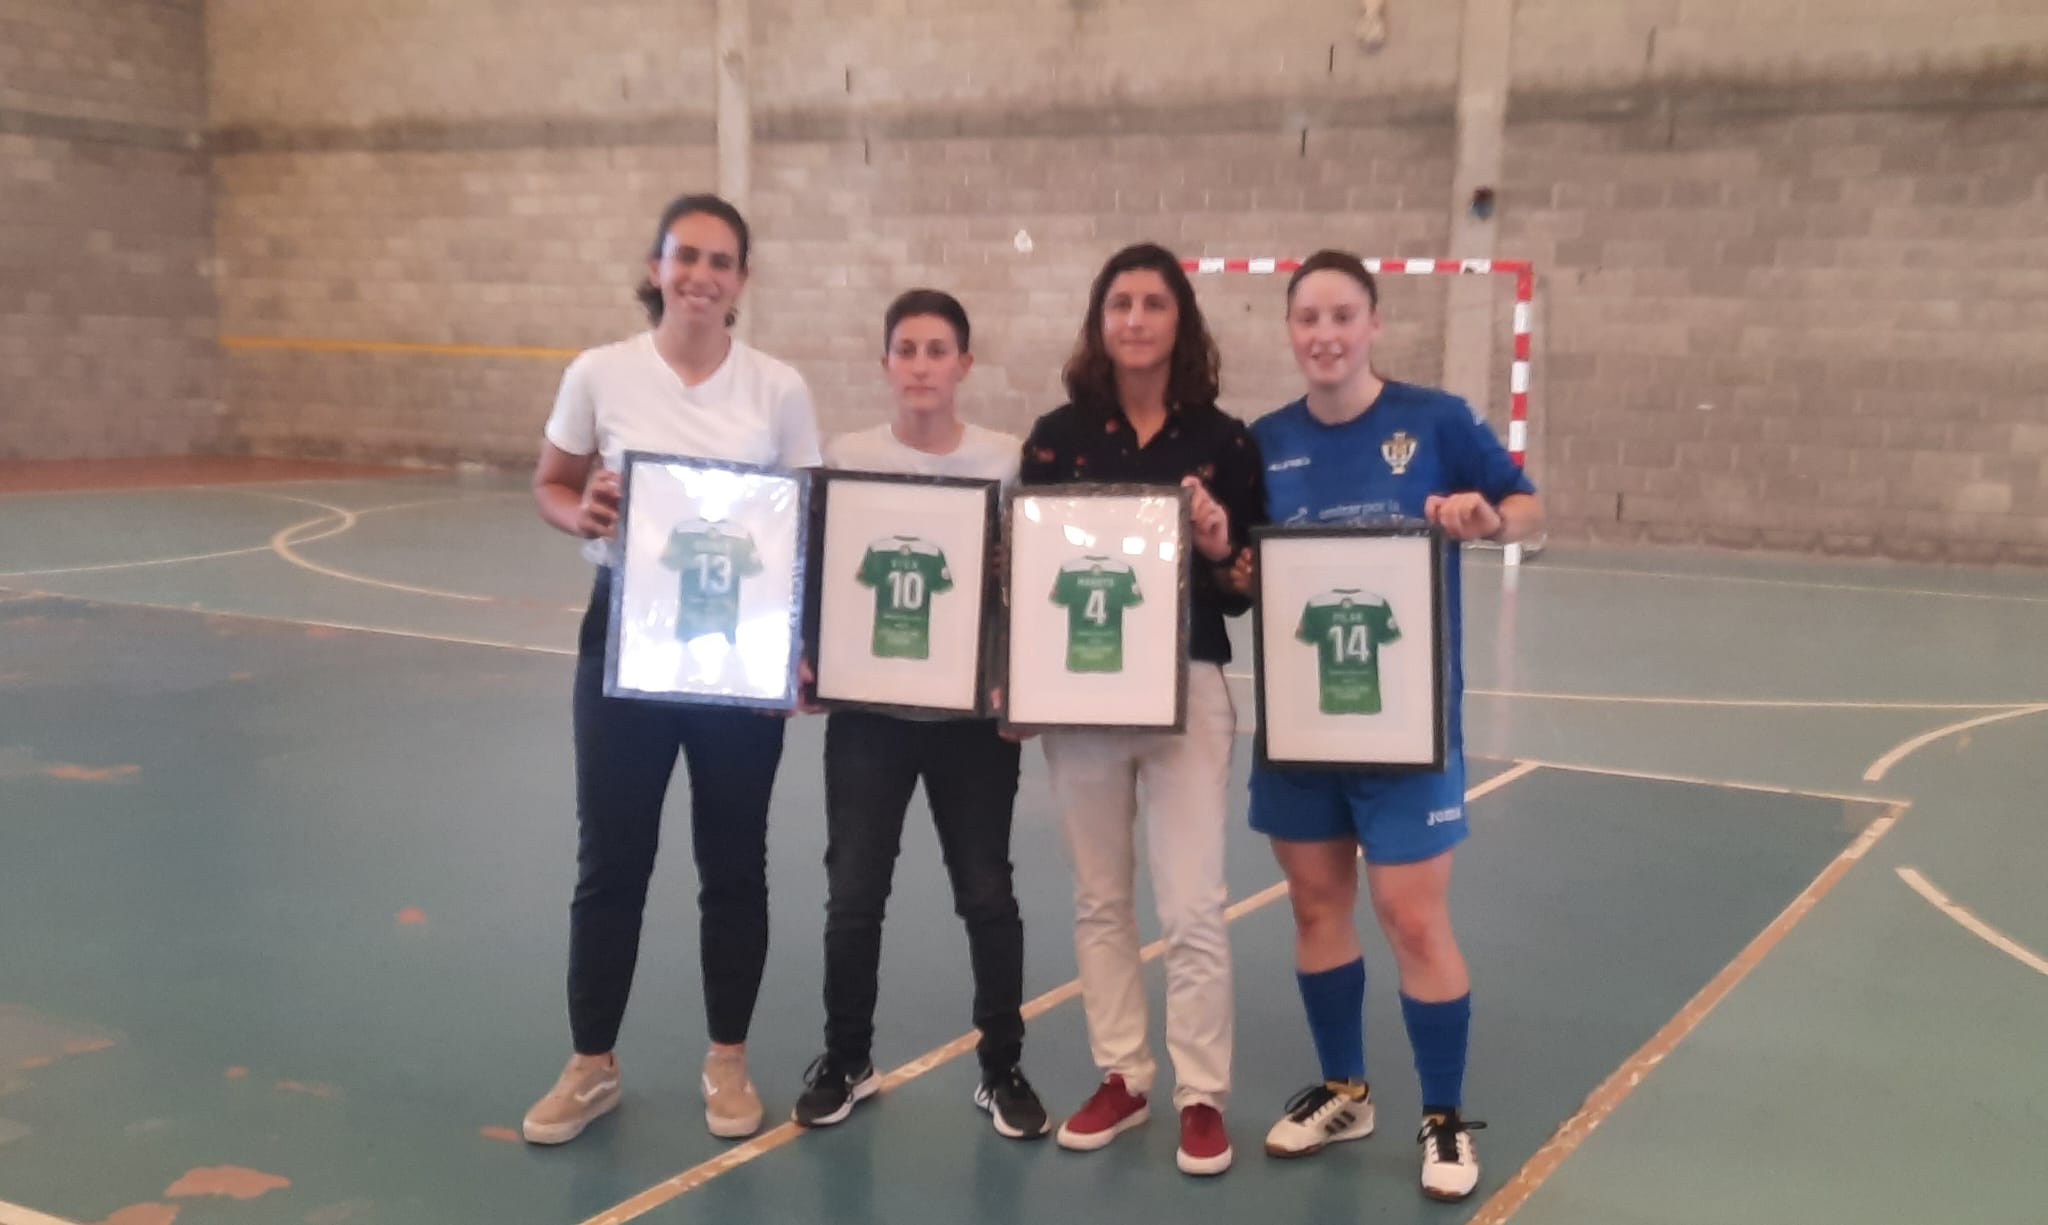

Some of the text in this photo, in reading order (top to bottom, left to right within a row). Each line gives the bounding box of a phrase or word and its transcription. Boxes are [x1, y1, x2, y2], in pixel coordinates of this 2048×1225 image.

[693, 553, 731, 593] 13
[888, 571, 924, 609] 10
[1085, 589, 1107, 624] 4
[1329, 624, 1369, 662] 14
